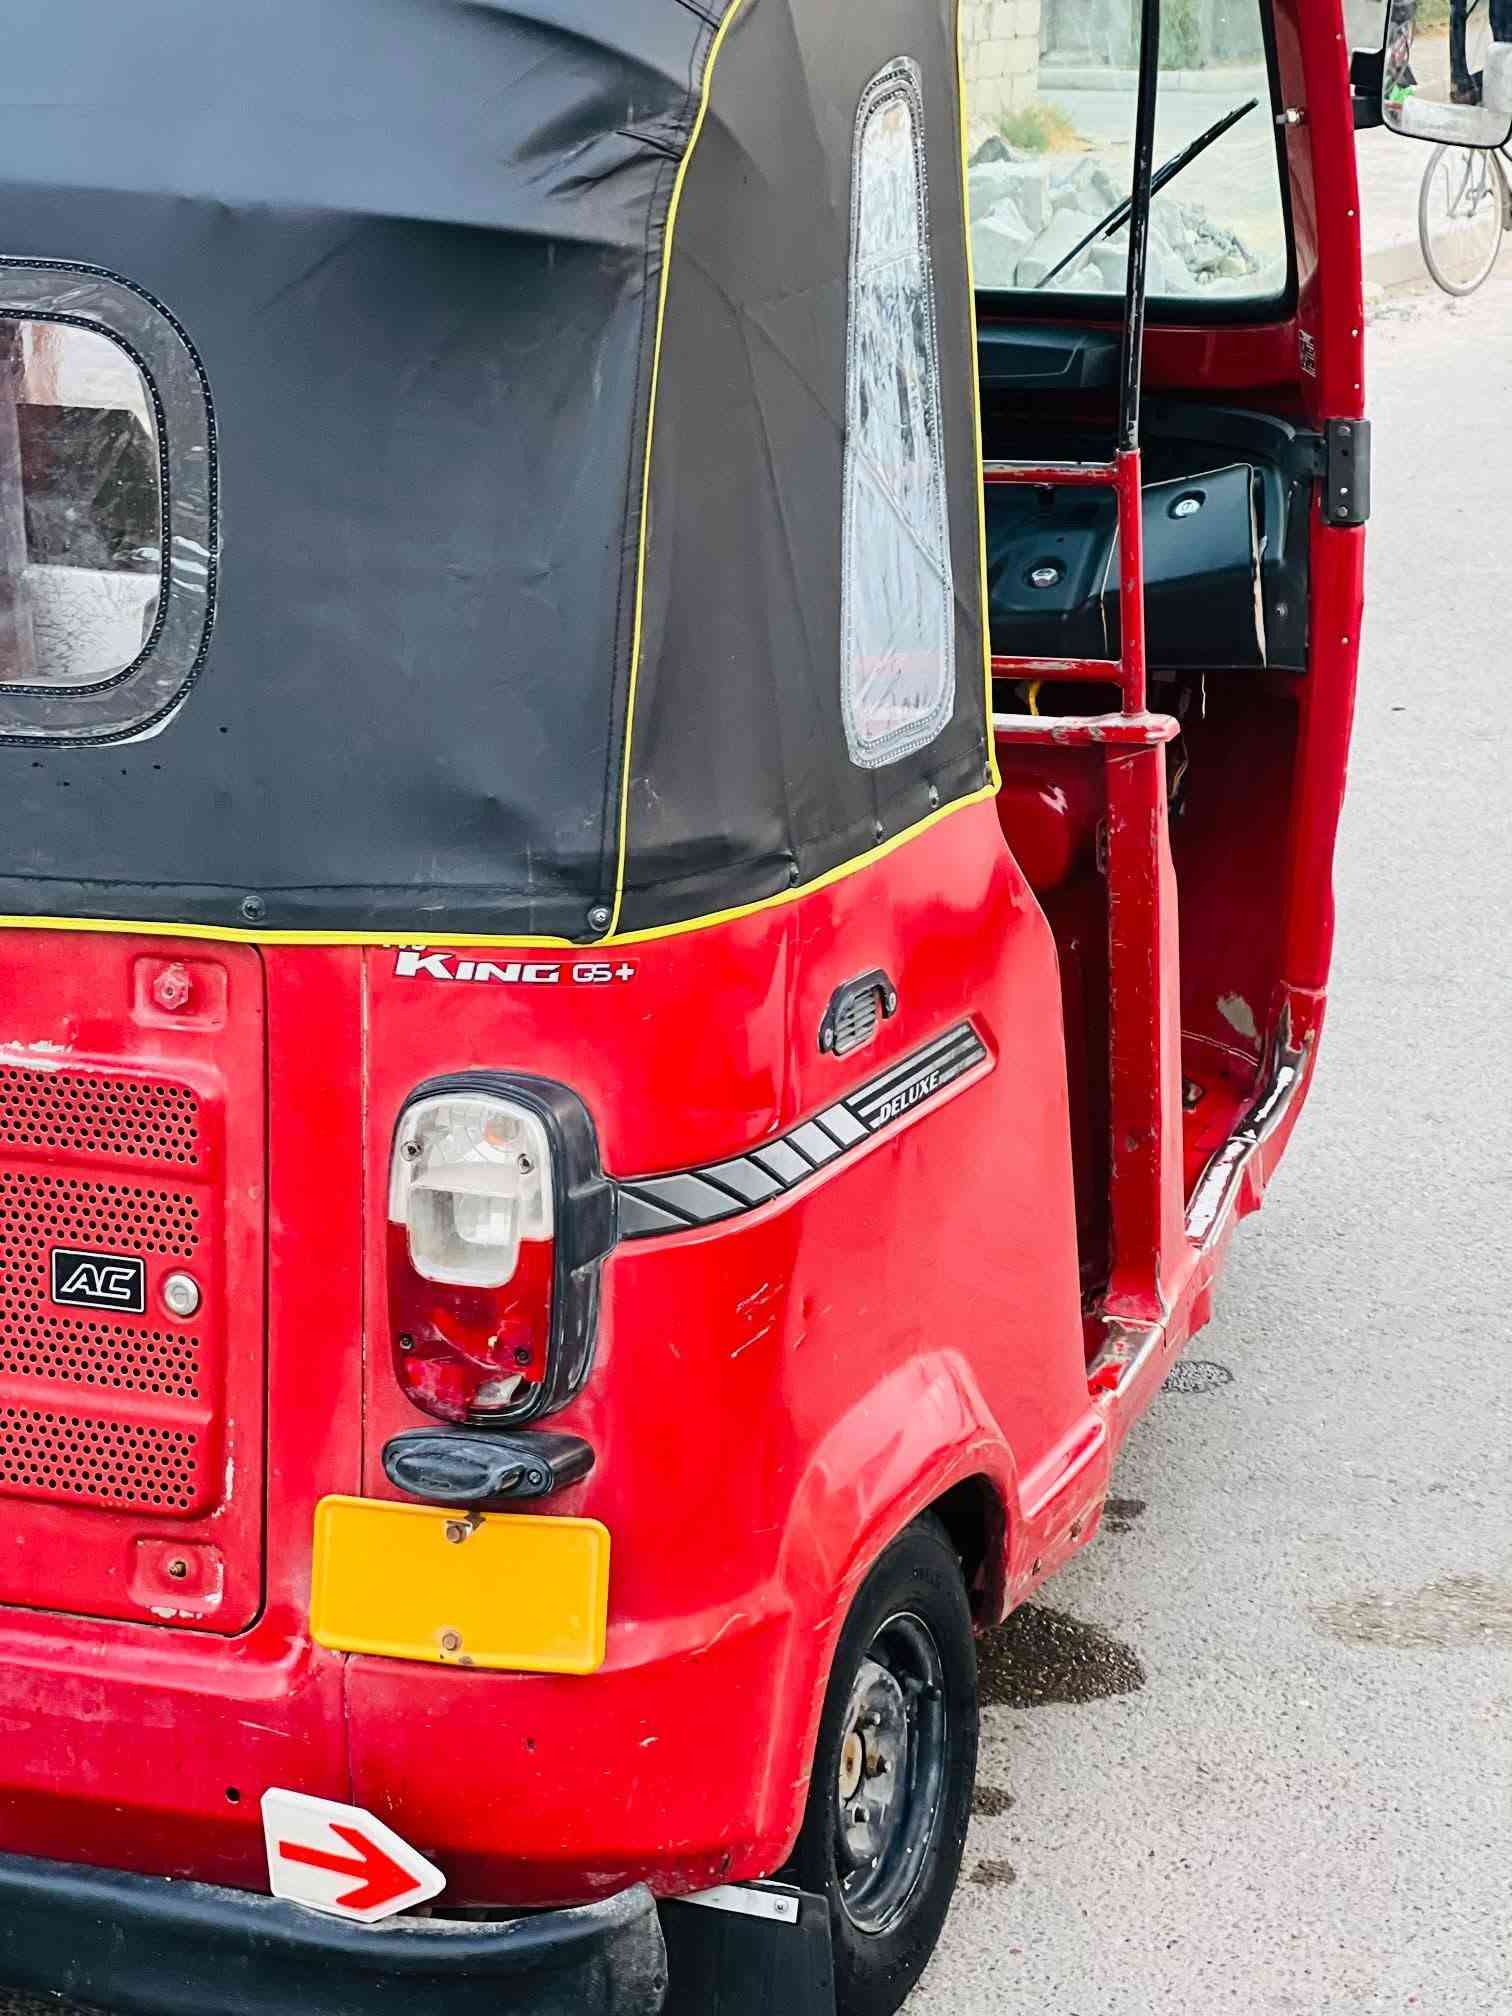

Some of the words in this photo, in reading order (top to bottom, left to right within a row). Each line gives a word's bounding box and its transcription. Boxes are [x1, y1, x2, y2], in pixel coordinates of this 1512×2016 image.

[395, 951, 560, 983] KING
[572, 963, 635, 983] GS+
[880, 1069, 940, 1122] DELUXE
[60, 1263, 137, 1300] AC
